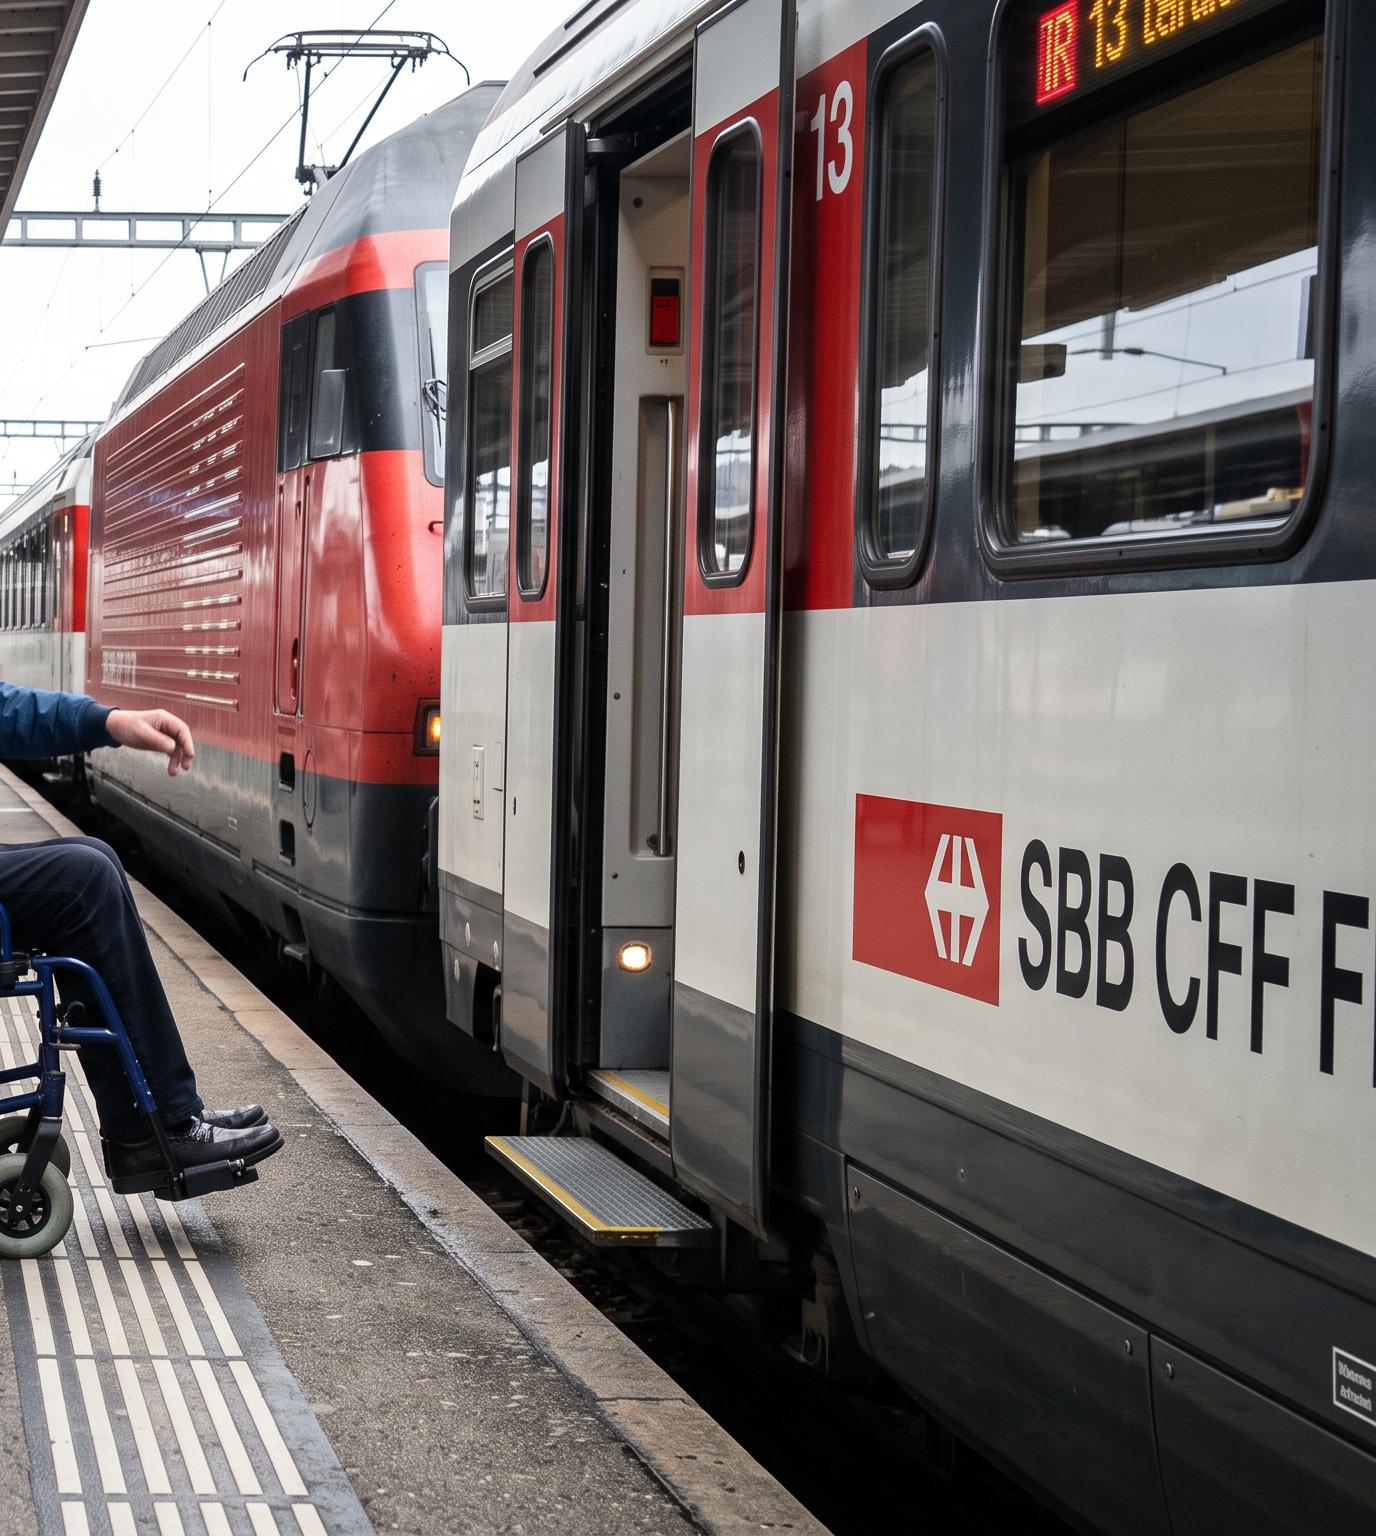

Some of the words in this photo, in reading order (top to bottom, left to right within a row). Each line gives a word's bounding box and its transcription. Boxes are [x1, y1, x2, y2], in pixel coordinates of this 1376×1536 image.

[1088, 0, 1127, 68] 13
[810, 80, 853, 202] 13
[1018, 838, 1135, 1012] SBB
[1155, 862, 1296, 1055] CFF
[1320, 889, 1376, 1088] F
